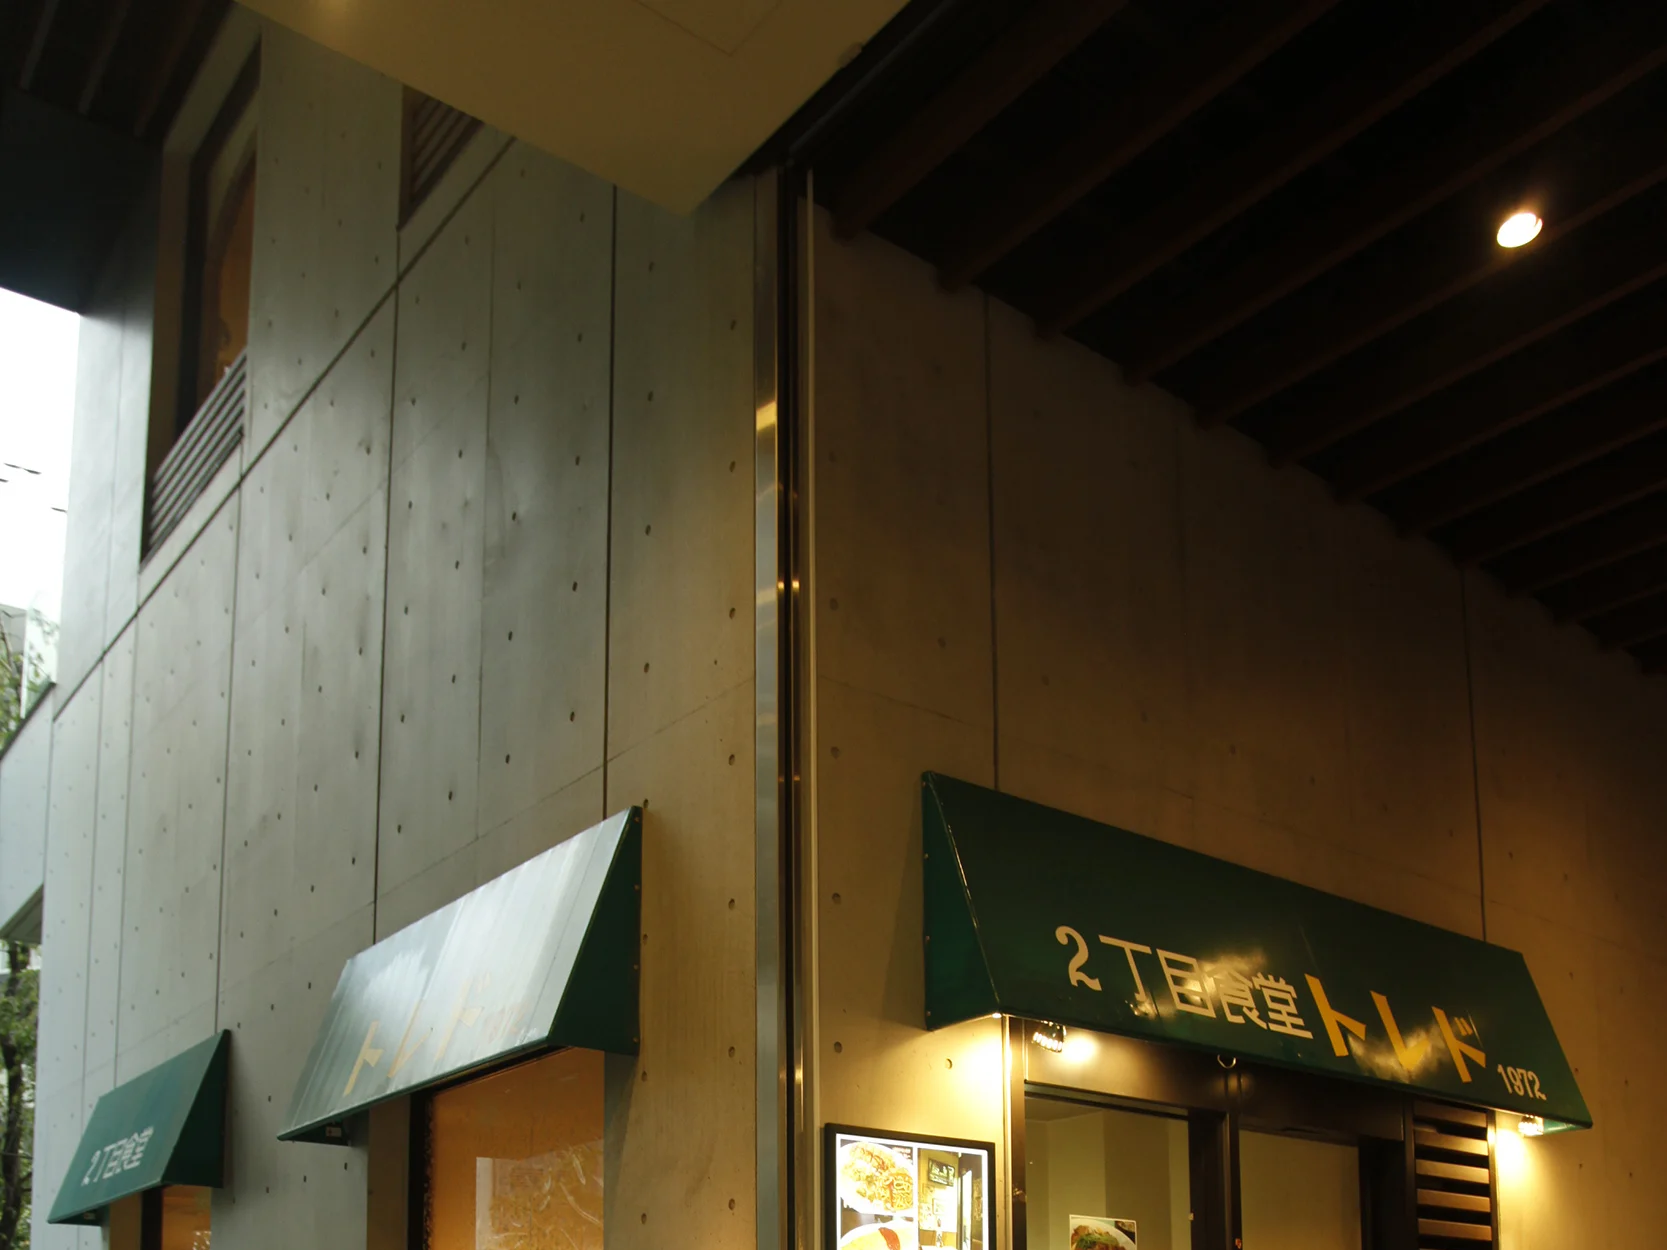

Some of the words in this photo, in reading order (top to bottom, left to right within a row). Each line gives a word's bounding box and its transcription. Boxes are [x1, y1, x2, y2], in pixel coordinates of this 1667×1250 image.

[1055, 925, 1313, 1040] 2丁目食堂
[1305, 973, 1486, 1084] トレド
[1496, 1063, 1547, 1101] 1972
